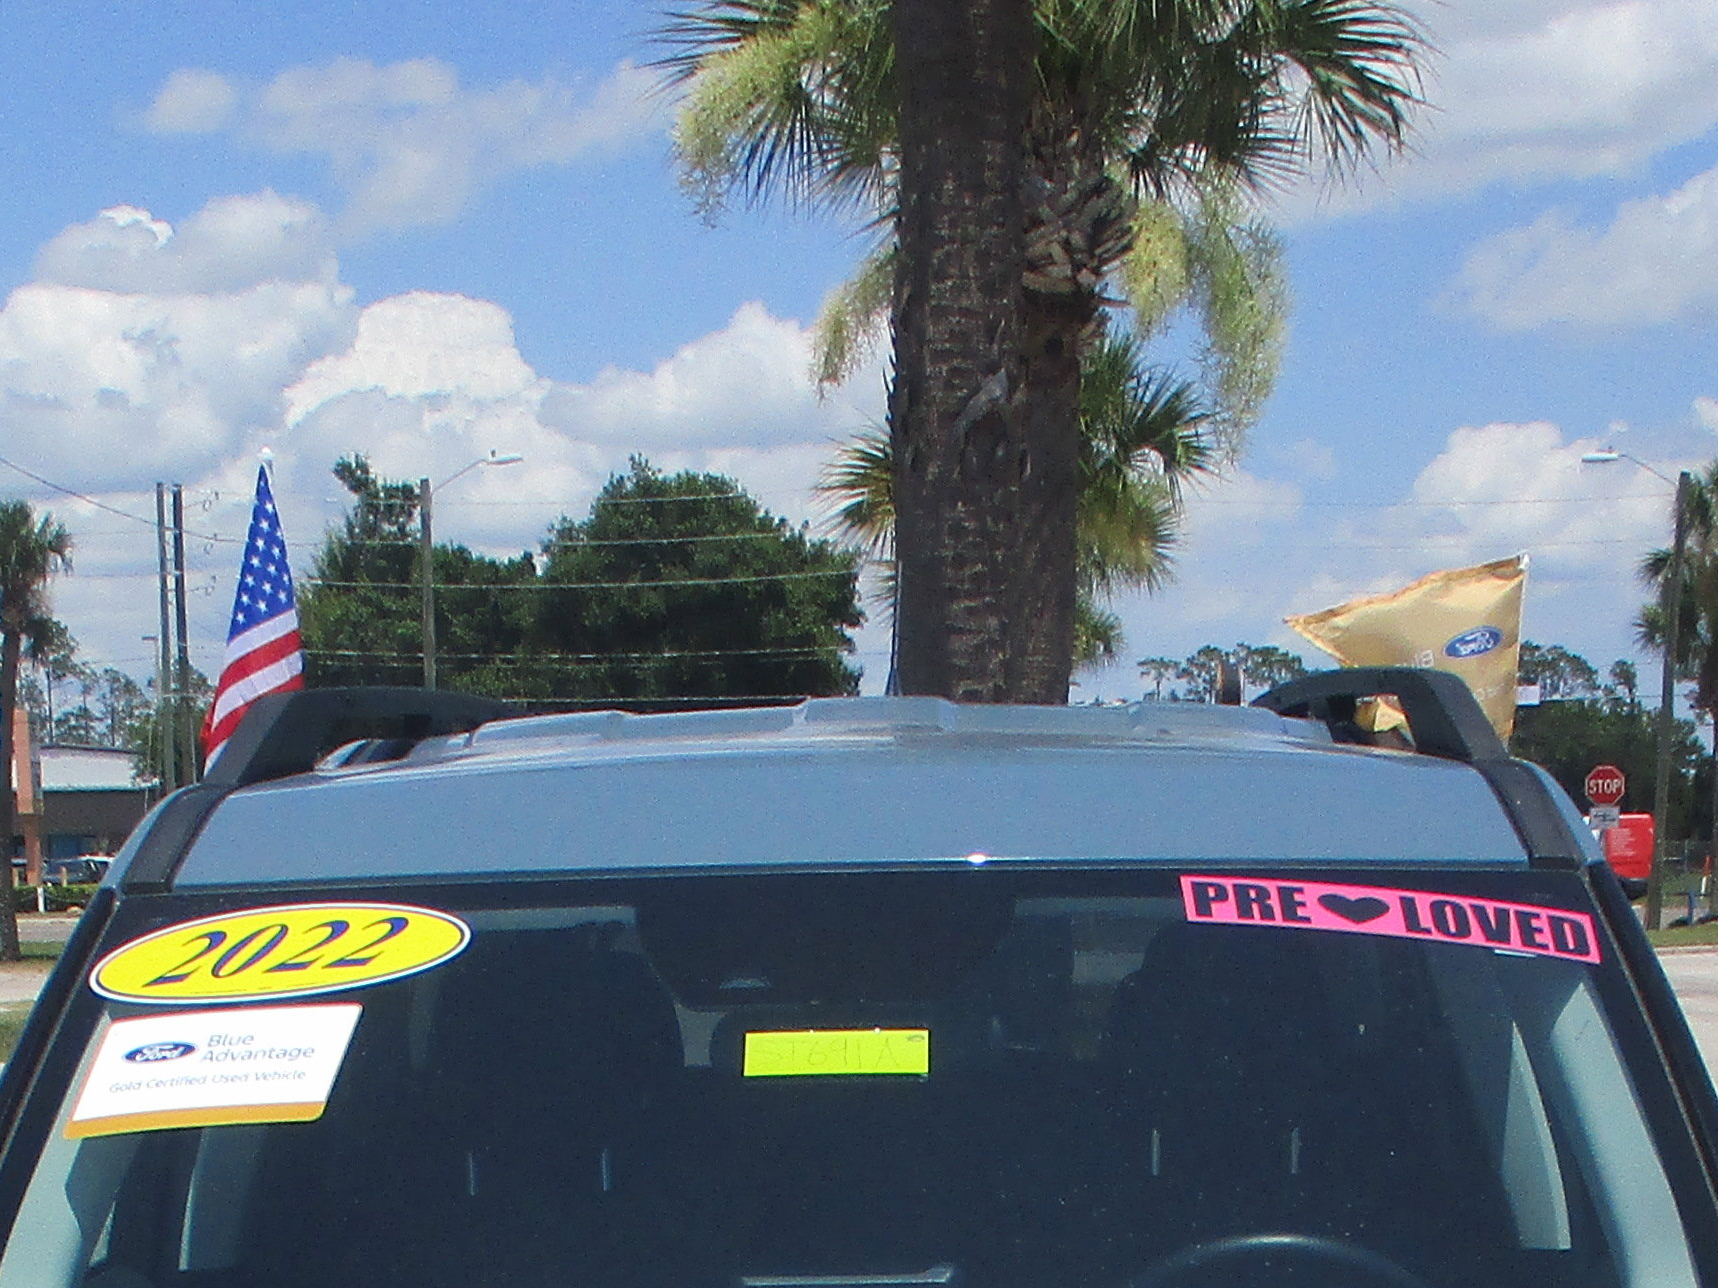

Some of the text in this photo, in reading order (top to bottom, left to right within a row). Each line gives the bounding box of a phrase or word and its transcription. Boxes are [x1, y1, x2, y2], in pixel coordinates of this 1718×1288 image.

[1588, 779, 1622, 795] STOP
[1191, 881, 1591, 955] PRE LOVED
[142, 917, 409, 988] 2022
[207, 1033, 255, 1048] Blue
[130, 1043, 190, 1062] Ford
[200, 1045, 316, 1063] Advantage
[109, 1068, 307, 1094] Gold Certified Used Vehicle
